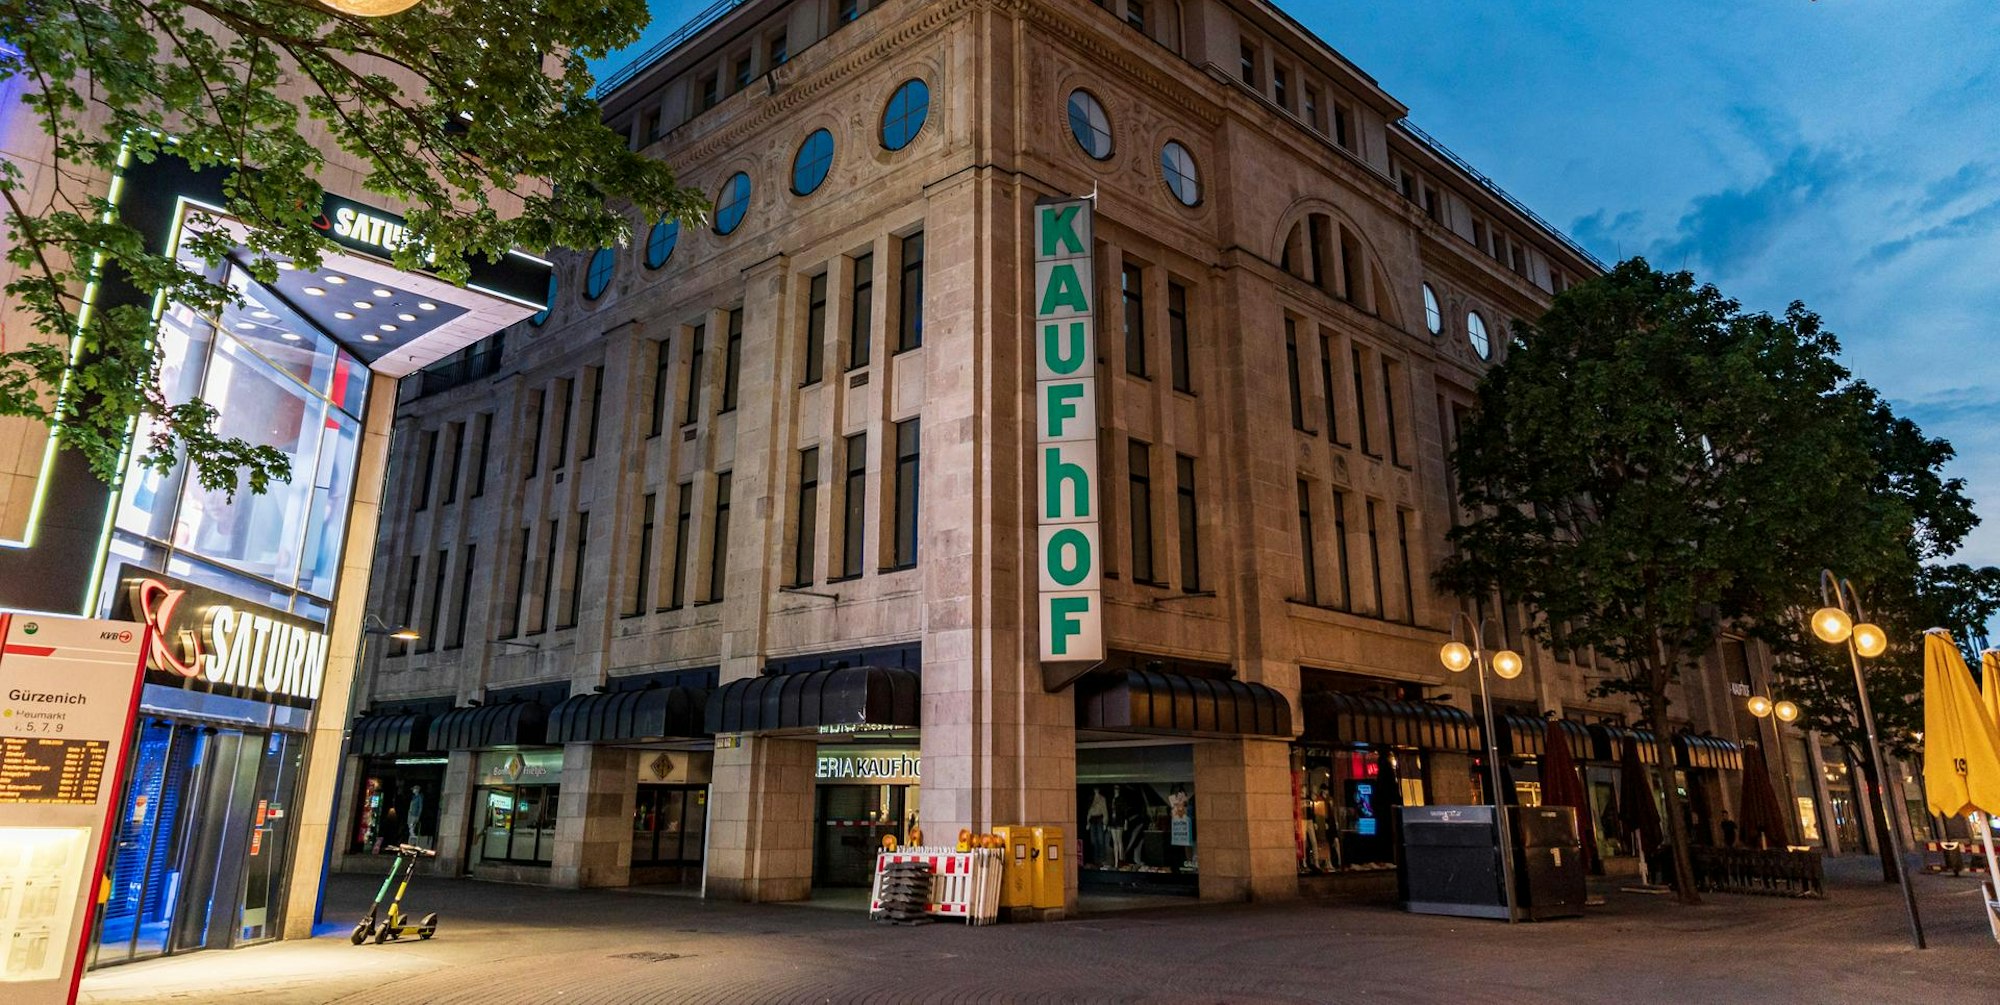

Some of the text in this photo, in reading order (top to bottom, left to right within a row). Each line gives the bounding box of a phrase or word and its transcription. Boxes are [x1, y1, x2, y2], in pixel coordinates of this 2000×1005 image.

[100, 631, 118, 640] KVB
[205, 605, 329, 699] SATURN
[9, 689, 87, 704] Gürzenich
[56, 723, 64, 732] 9
[815, 757, 854, 778] ERIA
